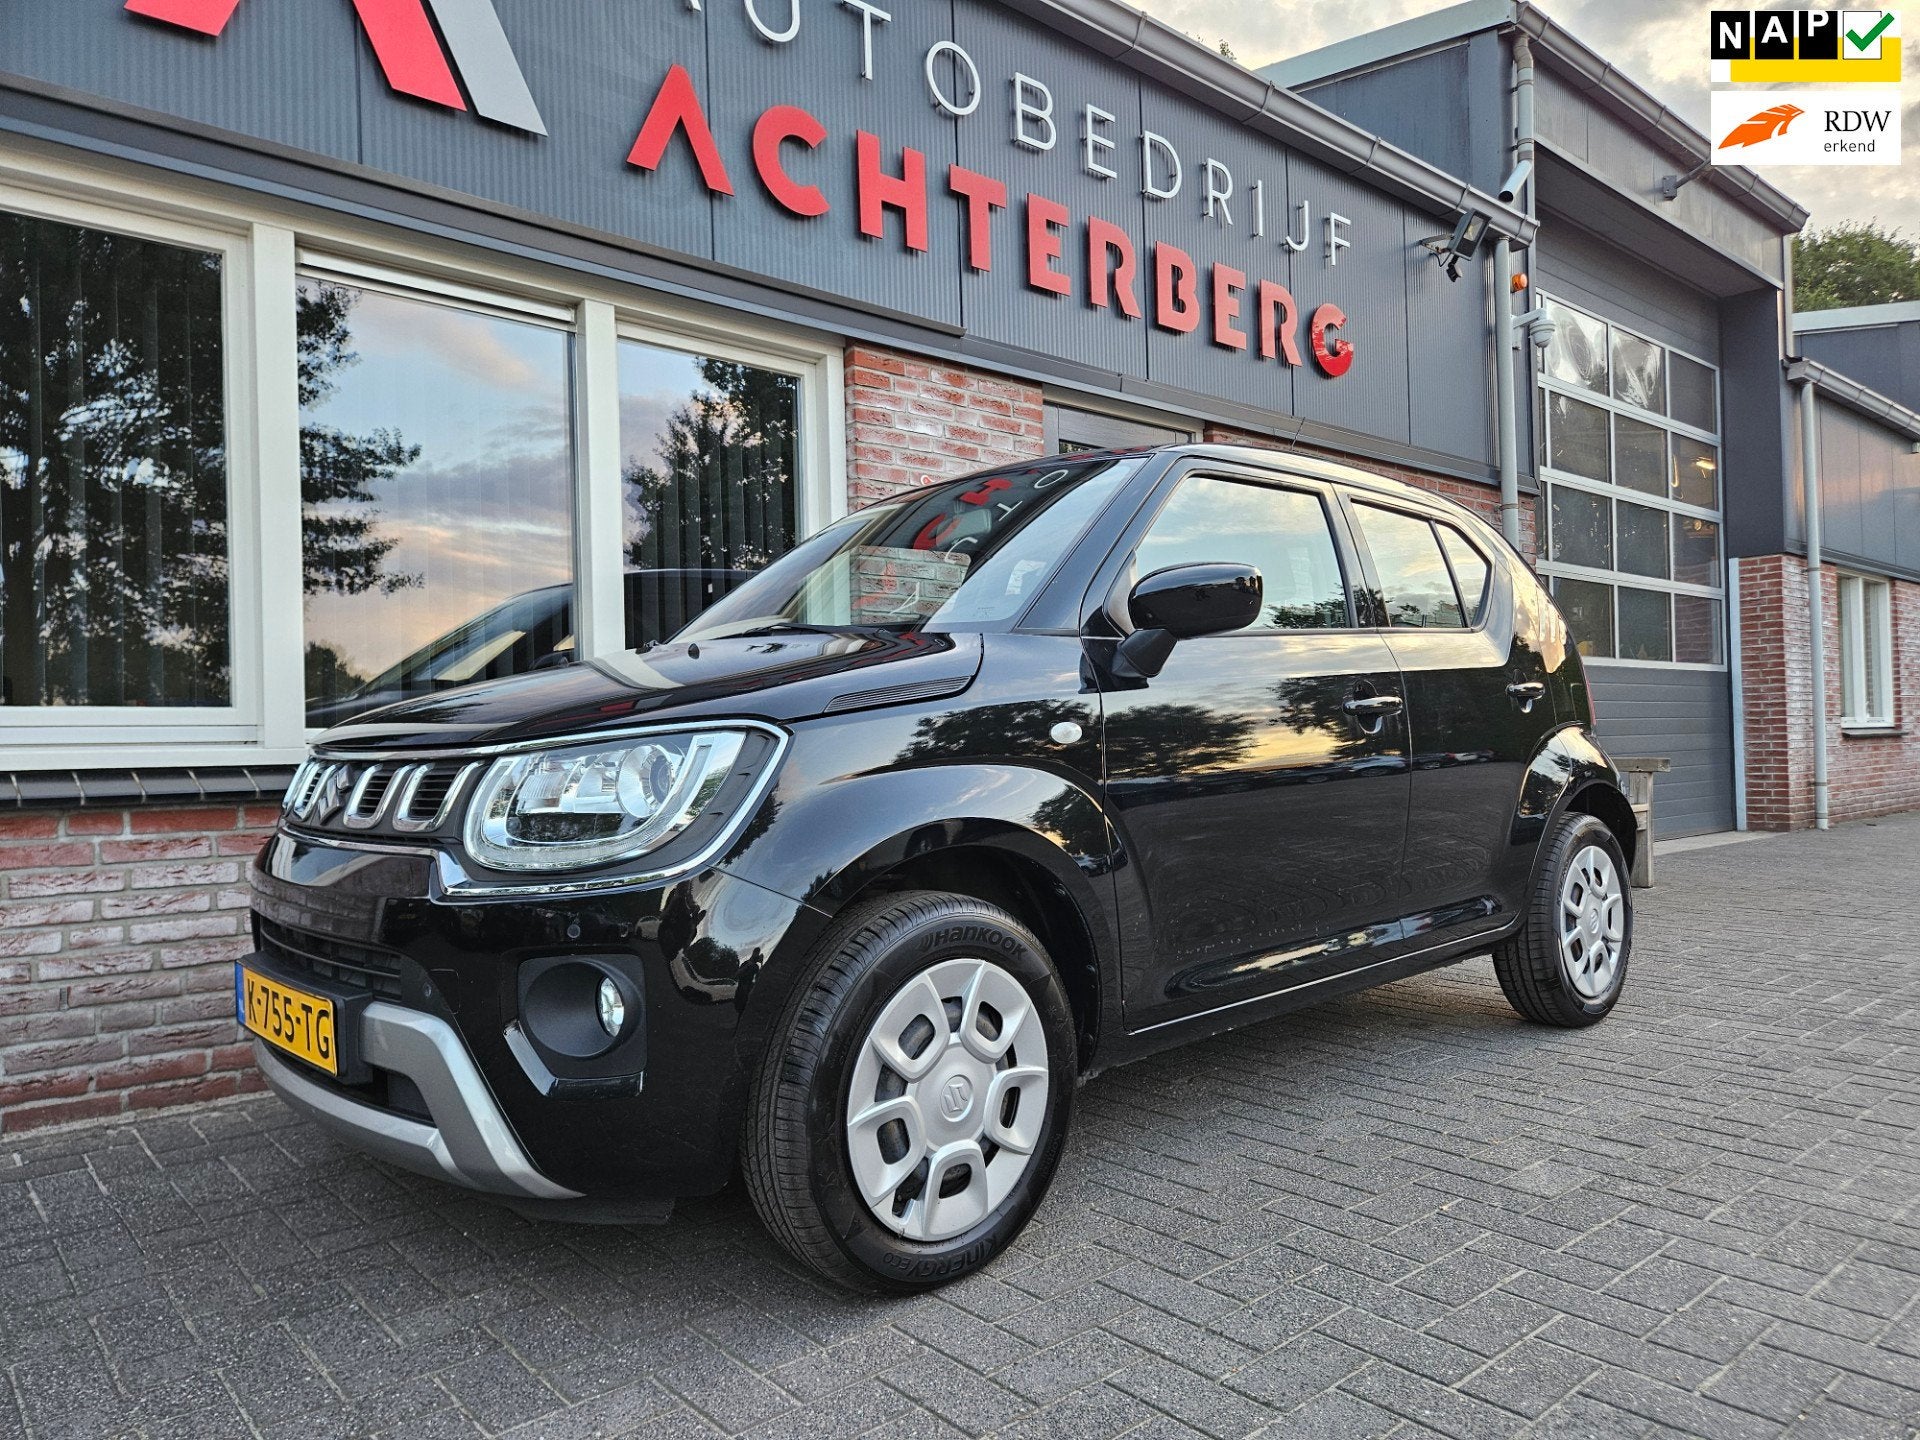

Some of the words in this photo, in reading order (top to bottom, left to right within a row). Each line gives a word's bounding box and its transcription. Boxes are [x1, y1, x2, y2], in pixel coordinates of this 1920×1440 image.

[626, 63, 1355, 377] ACHTERBERG
[690, 0, 1352, 266] UTOBEDRIJF
[247, 978, 330, 1059] K-755-TG
